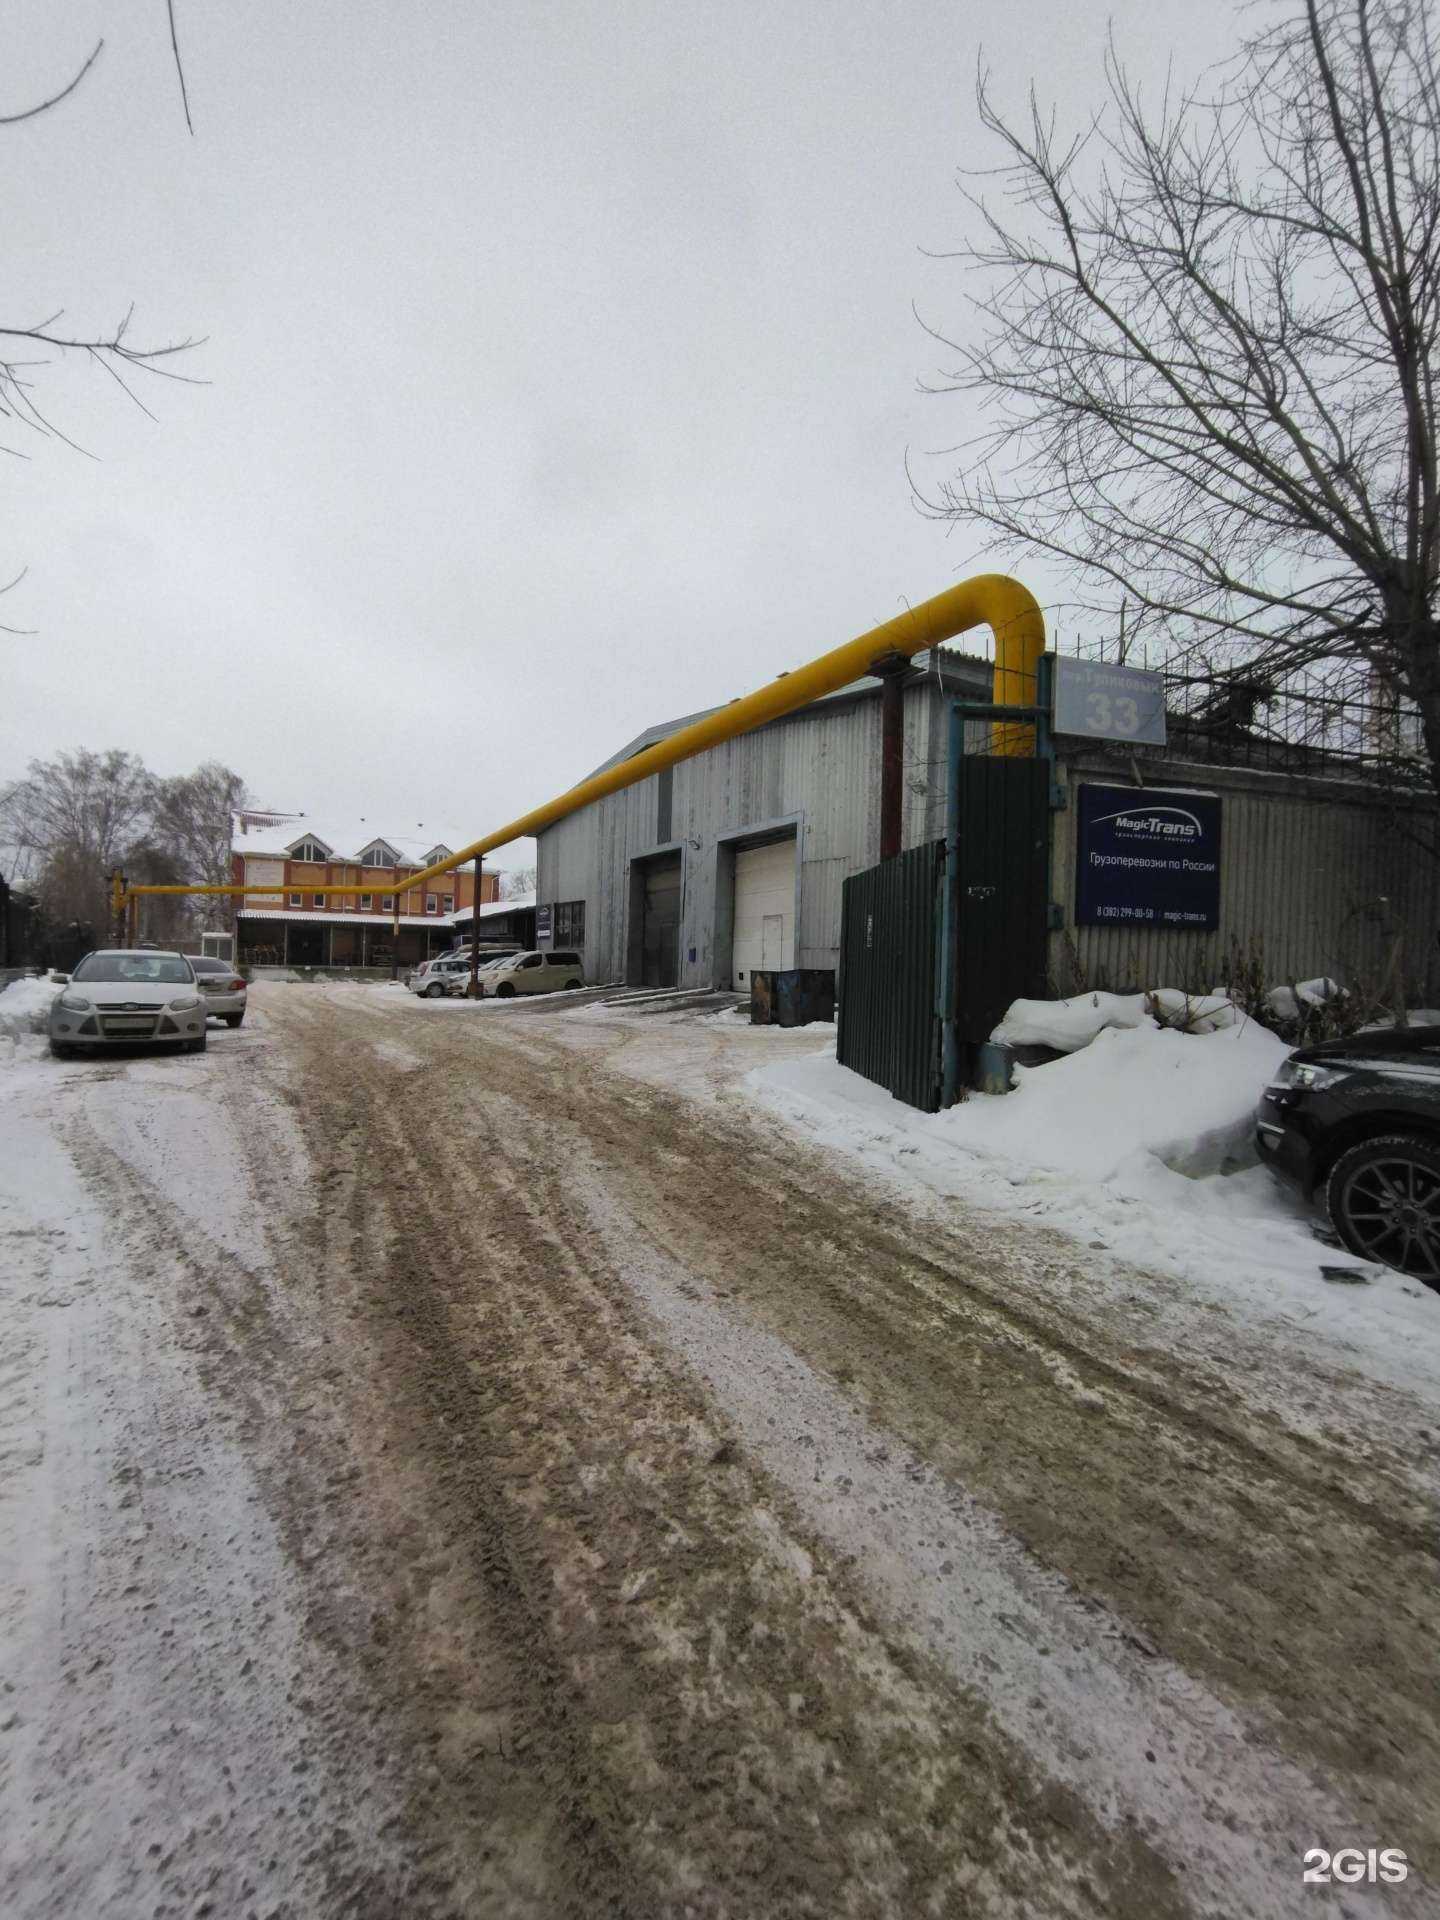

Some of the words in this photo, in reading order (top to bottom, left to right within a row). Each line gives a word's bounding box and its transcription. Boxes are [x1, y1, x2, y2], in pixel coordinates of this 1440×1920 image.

[1087, 692, 1139, 735] 33
[1116, 817, 1196, 835] MagicTrans
[1090, 852, 1167, 868] Грузоперевозки
[1168, 859, 1180, 870] по
[1182, 859, 1215, 872] России
